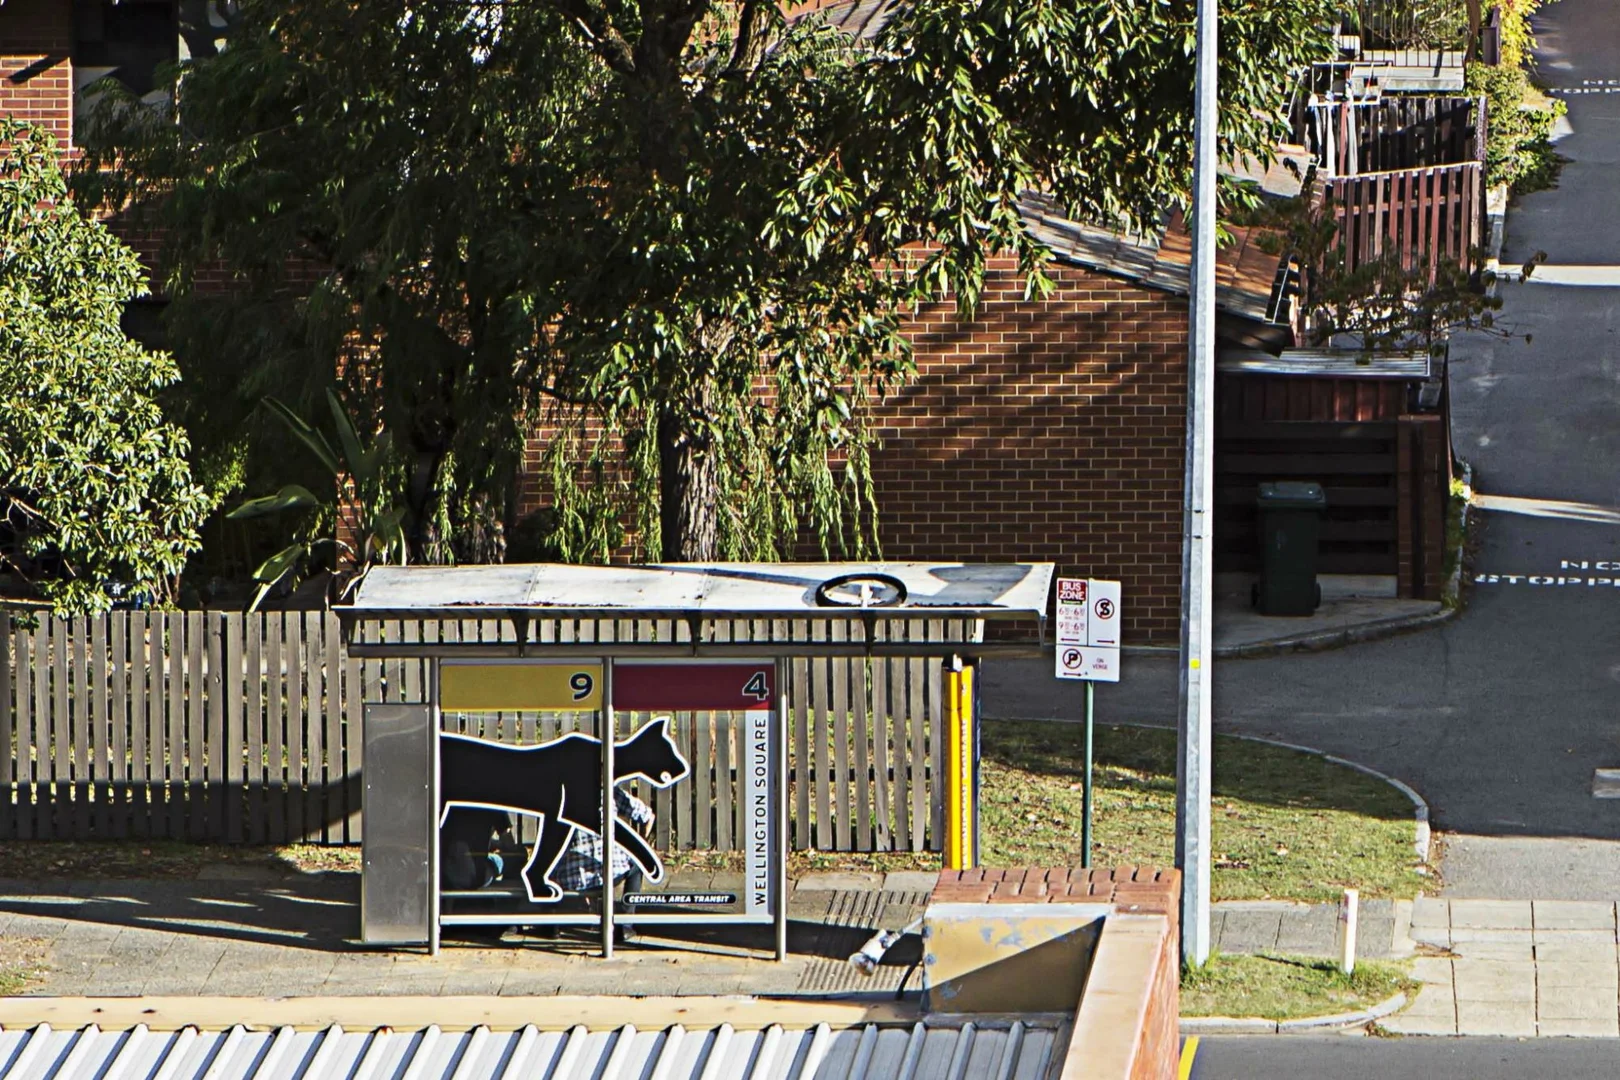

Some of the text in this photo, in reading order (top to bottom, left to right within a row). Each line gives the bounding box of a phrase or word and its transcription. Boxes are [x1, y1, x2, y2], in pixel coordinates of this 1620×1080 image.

[1059, 590, 1085, 600] ZONE
[1062, 582, 1082, 592] BUS
[569, 672, 594, 701] 9
[742, 671, 769, 701] 4
[754, 718, 766, 906] WELLINGTON SQUARE
[629, 895, 730, 903] CENTRAL AREA TRANSIT
